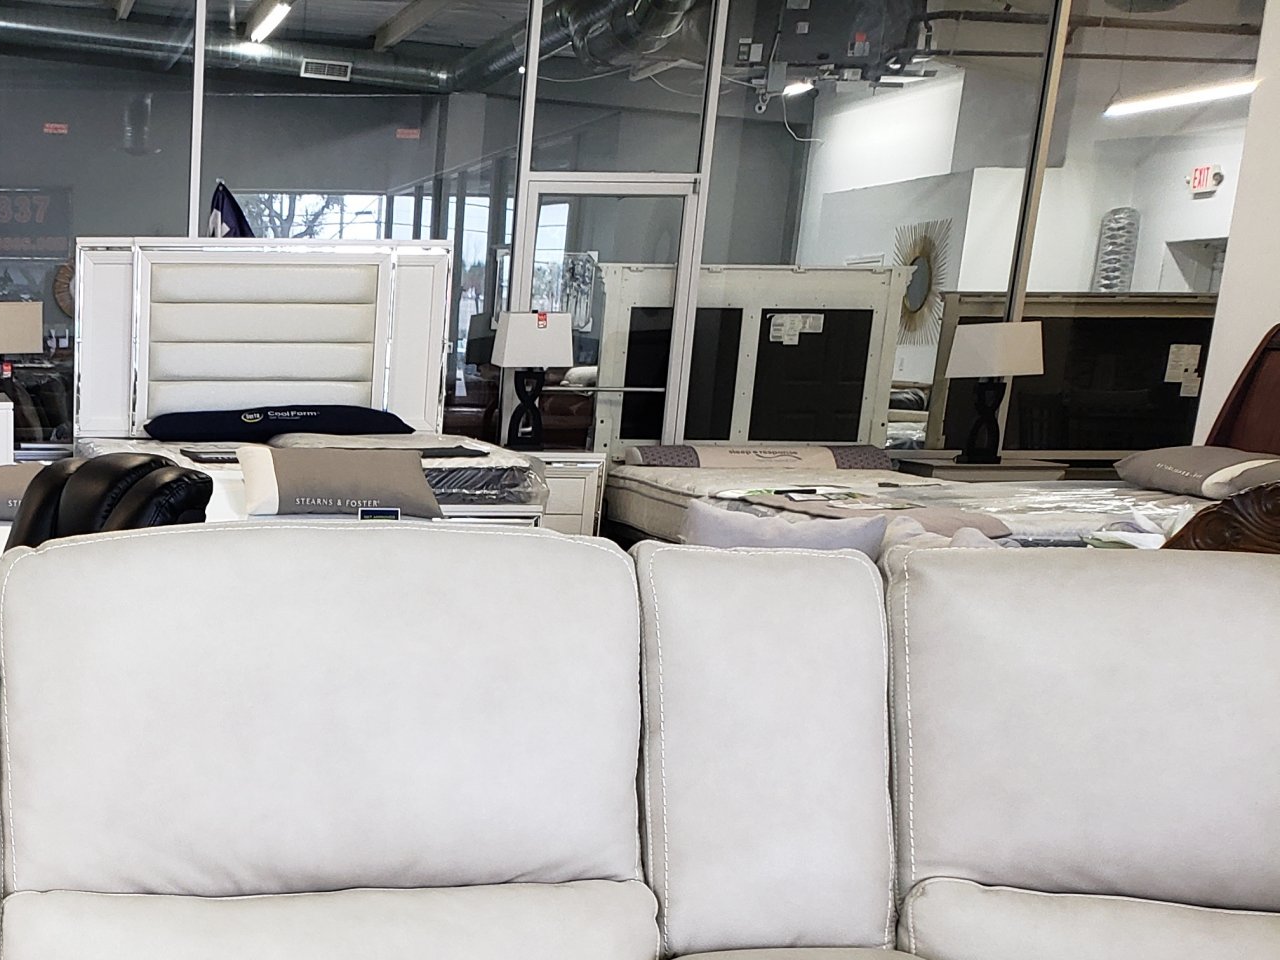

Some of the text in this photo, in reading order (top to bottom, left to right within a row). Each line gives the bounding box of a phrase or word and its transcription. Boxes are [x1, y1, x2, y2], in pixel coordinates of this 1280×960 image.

[1193, 166, 1210, 189] EXIT
[295, 497, 333, 506] STEARNS
[345, 499, 378, 507] FOSTER
